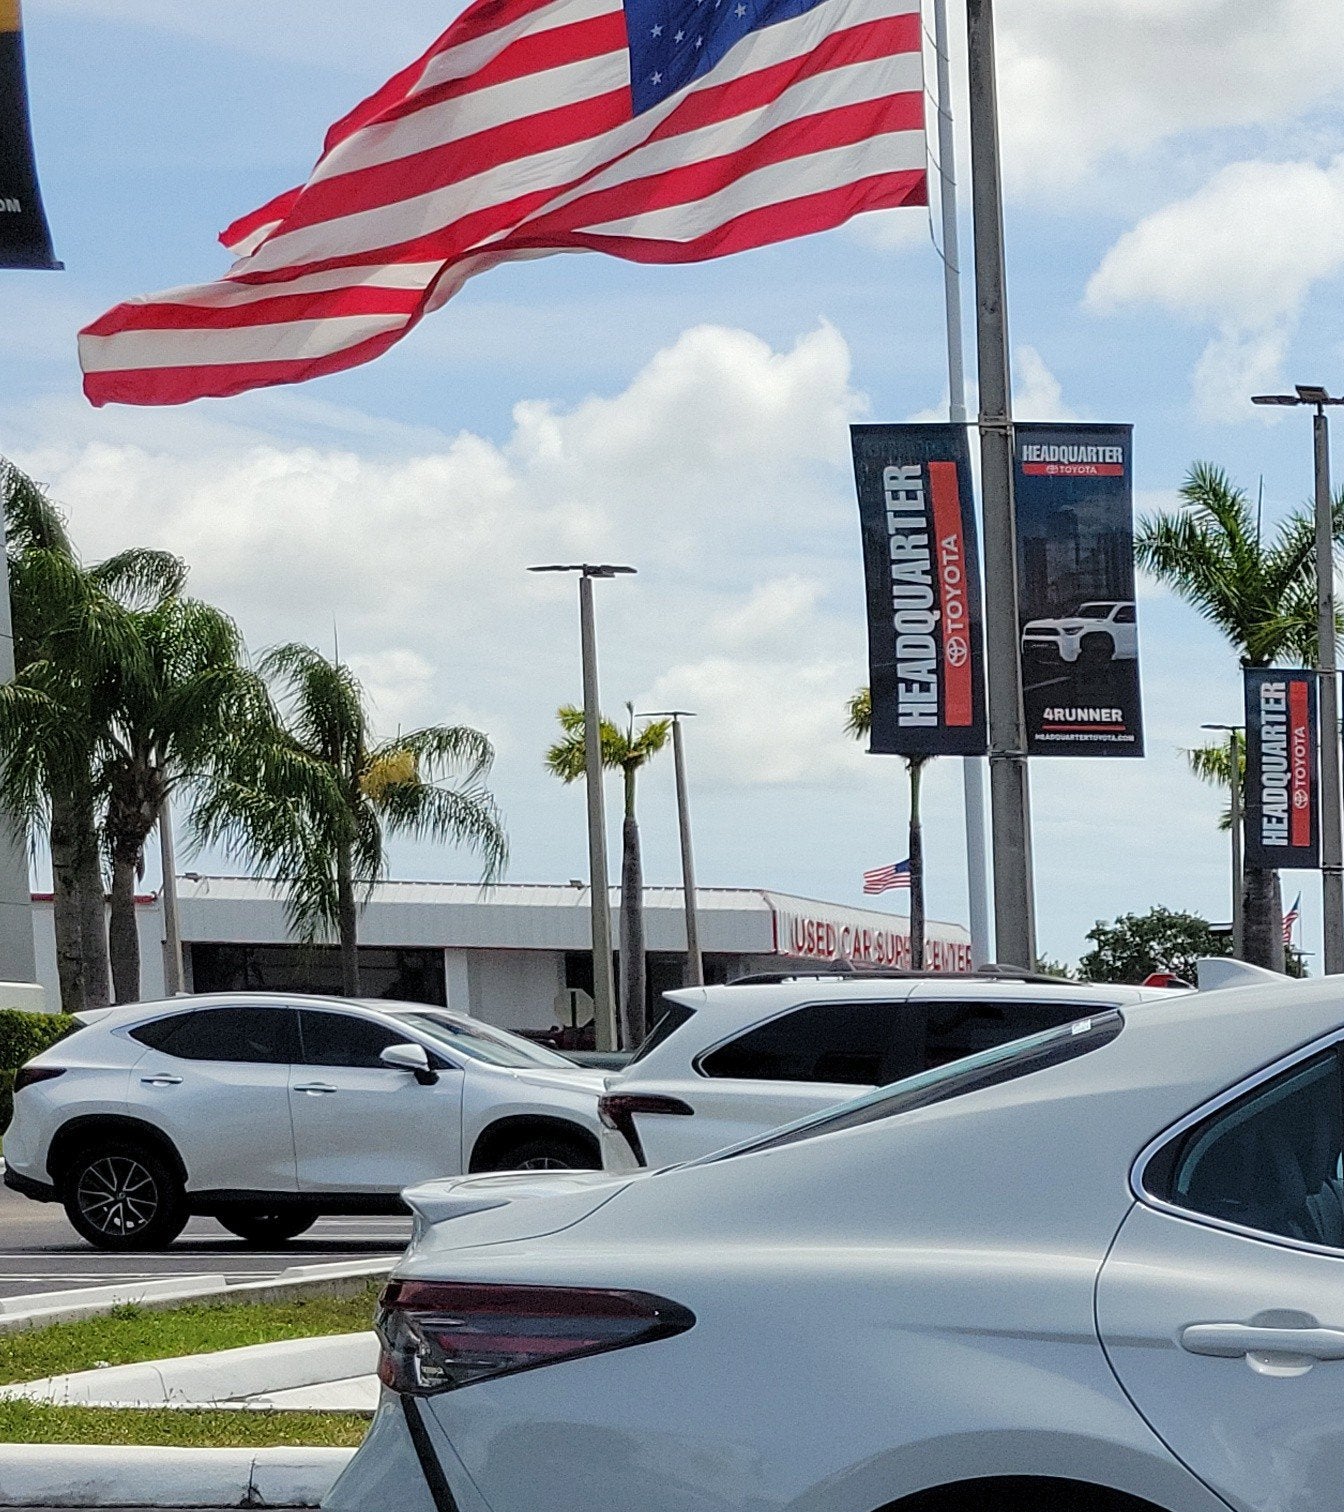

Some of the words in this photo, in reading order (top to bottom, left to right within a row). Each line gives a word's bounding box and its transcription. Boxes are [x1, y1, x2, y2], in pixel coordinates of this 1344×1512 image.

[1022, 445, 1124, 464] HEADQUARTER
[1060, 465, 1098, 474] TOYOTA
[883, 463, 941, 727] HEADQUARTER
[940, 534, 964, 633] TOYOTA
[1042, 708, 1123, 722] 4RUNNER
[1261, 682, 1291, 846] HEADQUARTER
[1294, 726, 1307, 786] TOYOTA
[793, 917, 836, 957] USED
[841, 926, 872, 962] CAR
